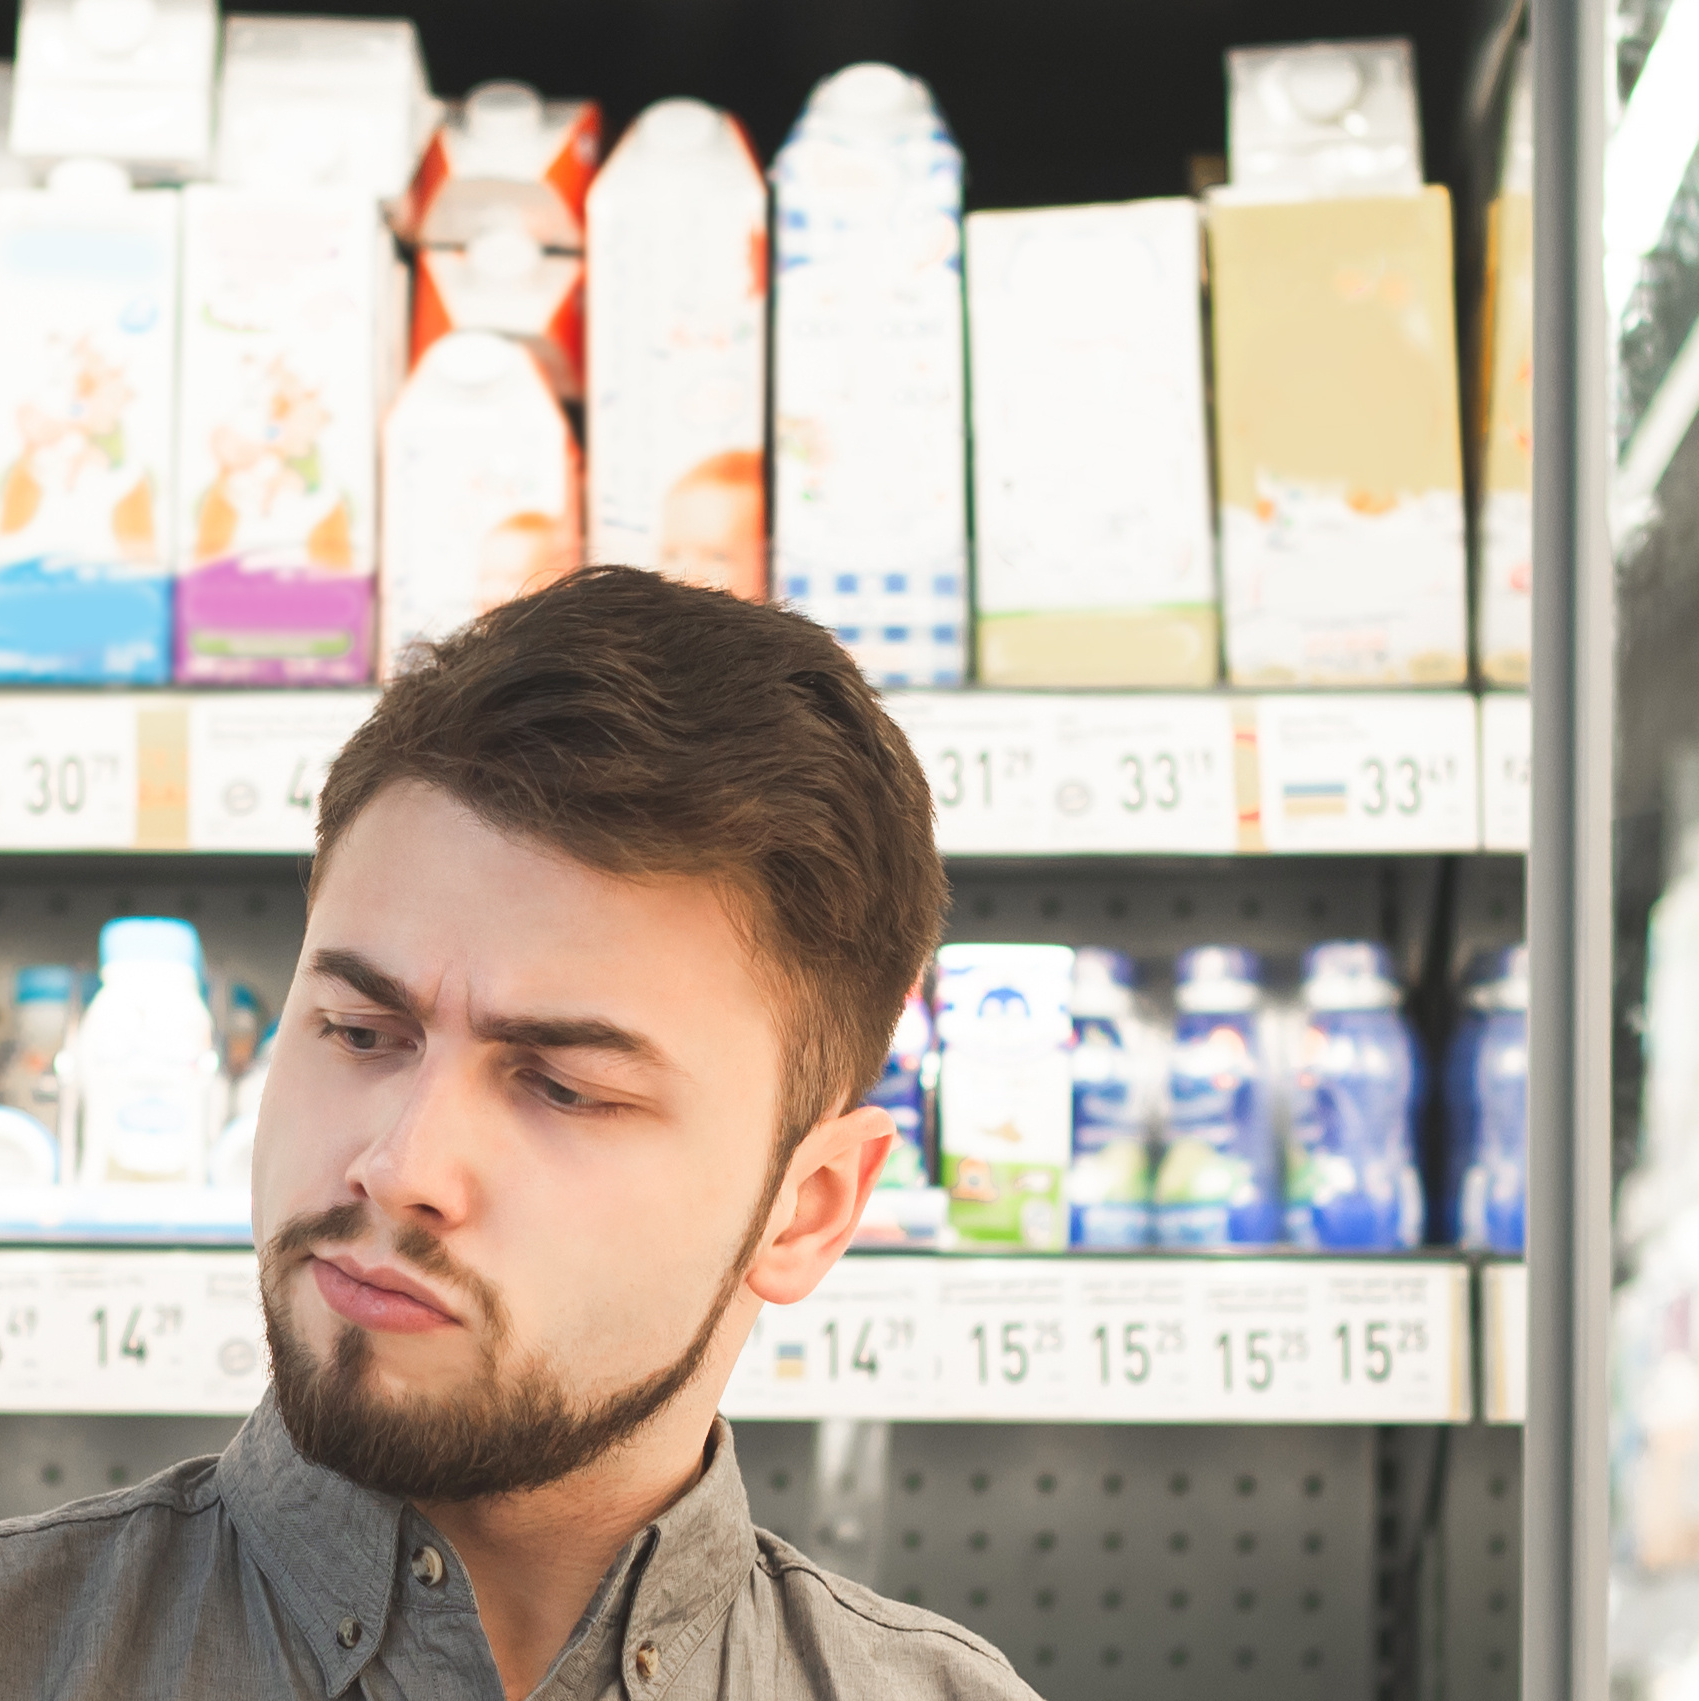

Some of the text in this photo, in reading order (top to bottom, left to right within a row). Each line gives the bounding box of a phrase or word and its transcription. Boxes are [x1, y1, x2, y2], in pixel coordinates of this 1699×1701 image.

[23, 755, 86, 816] 30
[938, 748, 993, 808] 31
[1119, 751, 1182, 813] 33
[1361, 754, 1423, 817] 33
[90, 1303, 149, 1370] 14
[821, 1317, 882, 1382] 14
[968, 1321, 1029, 1386] 15
[1090, 1321, 1152, 1386] 15
[1214, 1330, 1274, 1394] 15
[1331, 1319, 1393, 1384] 15
